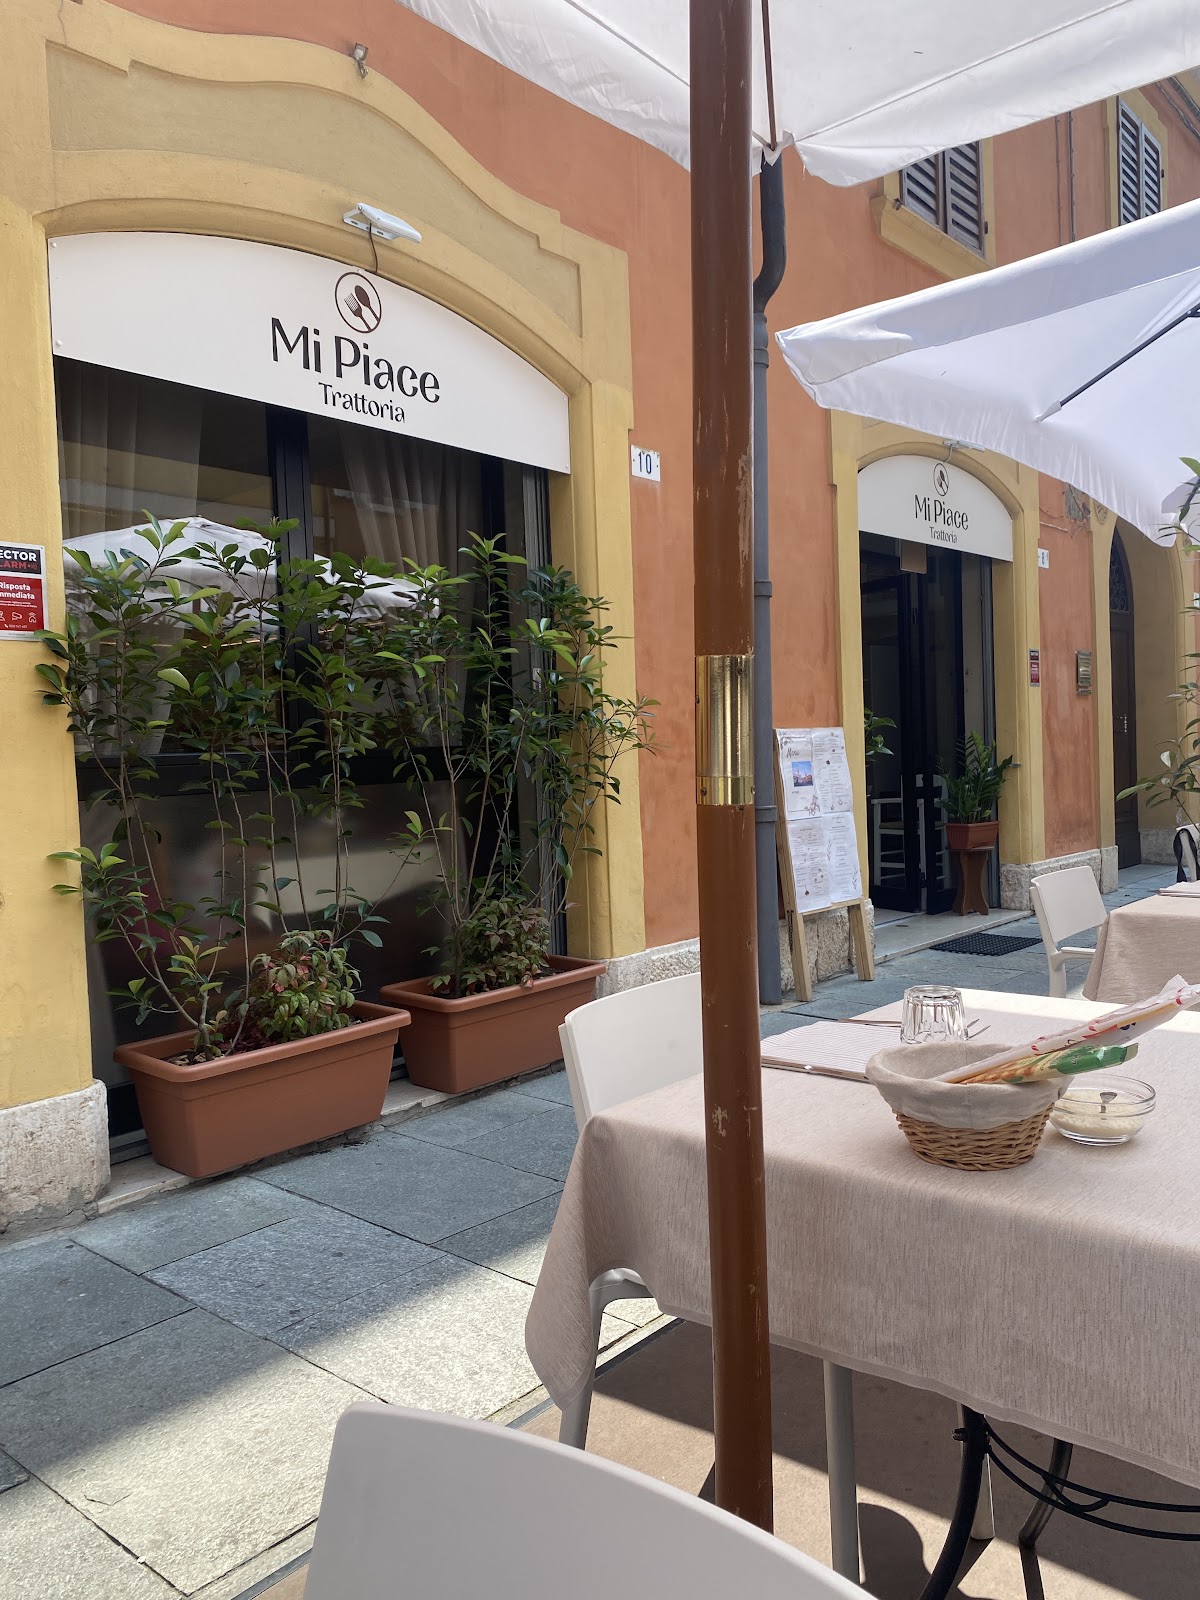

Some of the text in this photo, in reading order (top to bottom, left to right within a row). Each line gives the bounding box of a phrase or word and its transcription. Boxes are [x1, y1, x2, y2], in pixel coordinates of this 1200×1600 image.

[271, 317, 440, 403] Mi Piace
[318, 382, 405, 423] Trattoria
[638, 451, 652, 474] 10
[914, 494, 969, 530] Mi Piace
[929, 526, 957, 543] Trattoria
